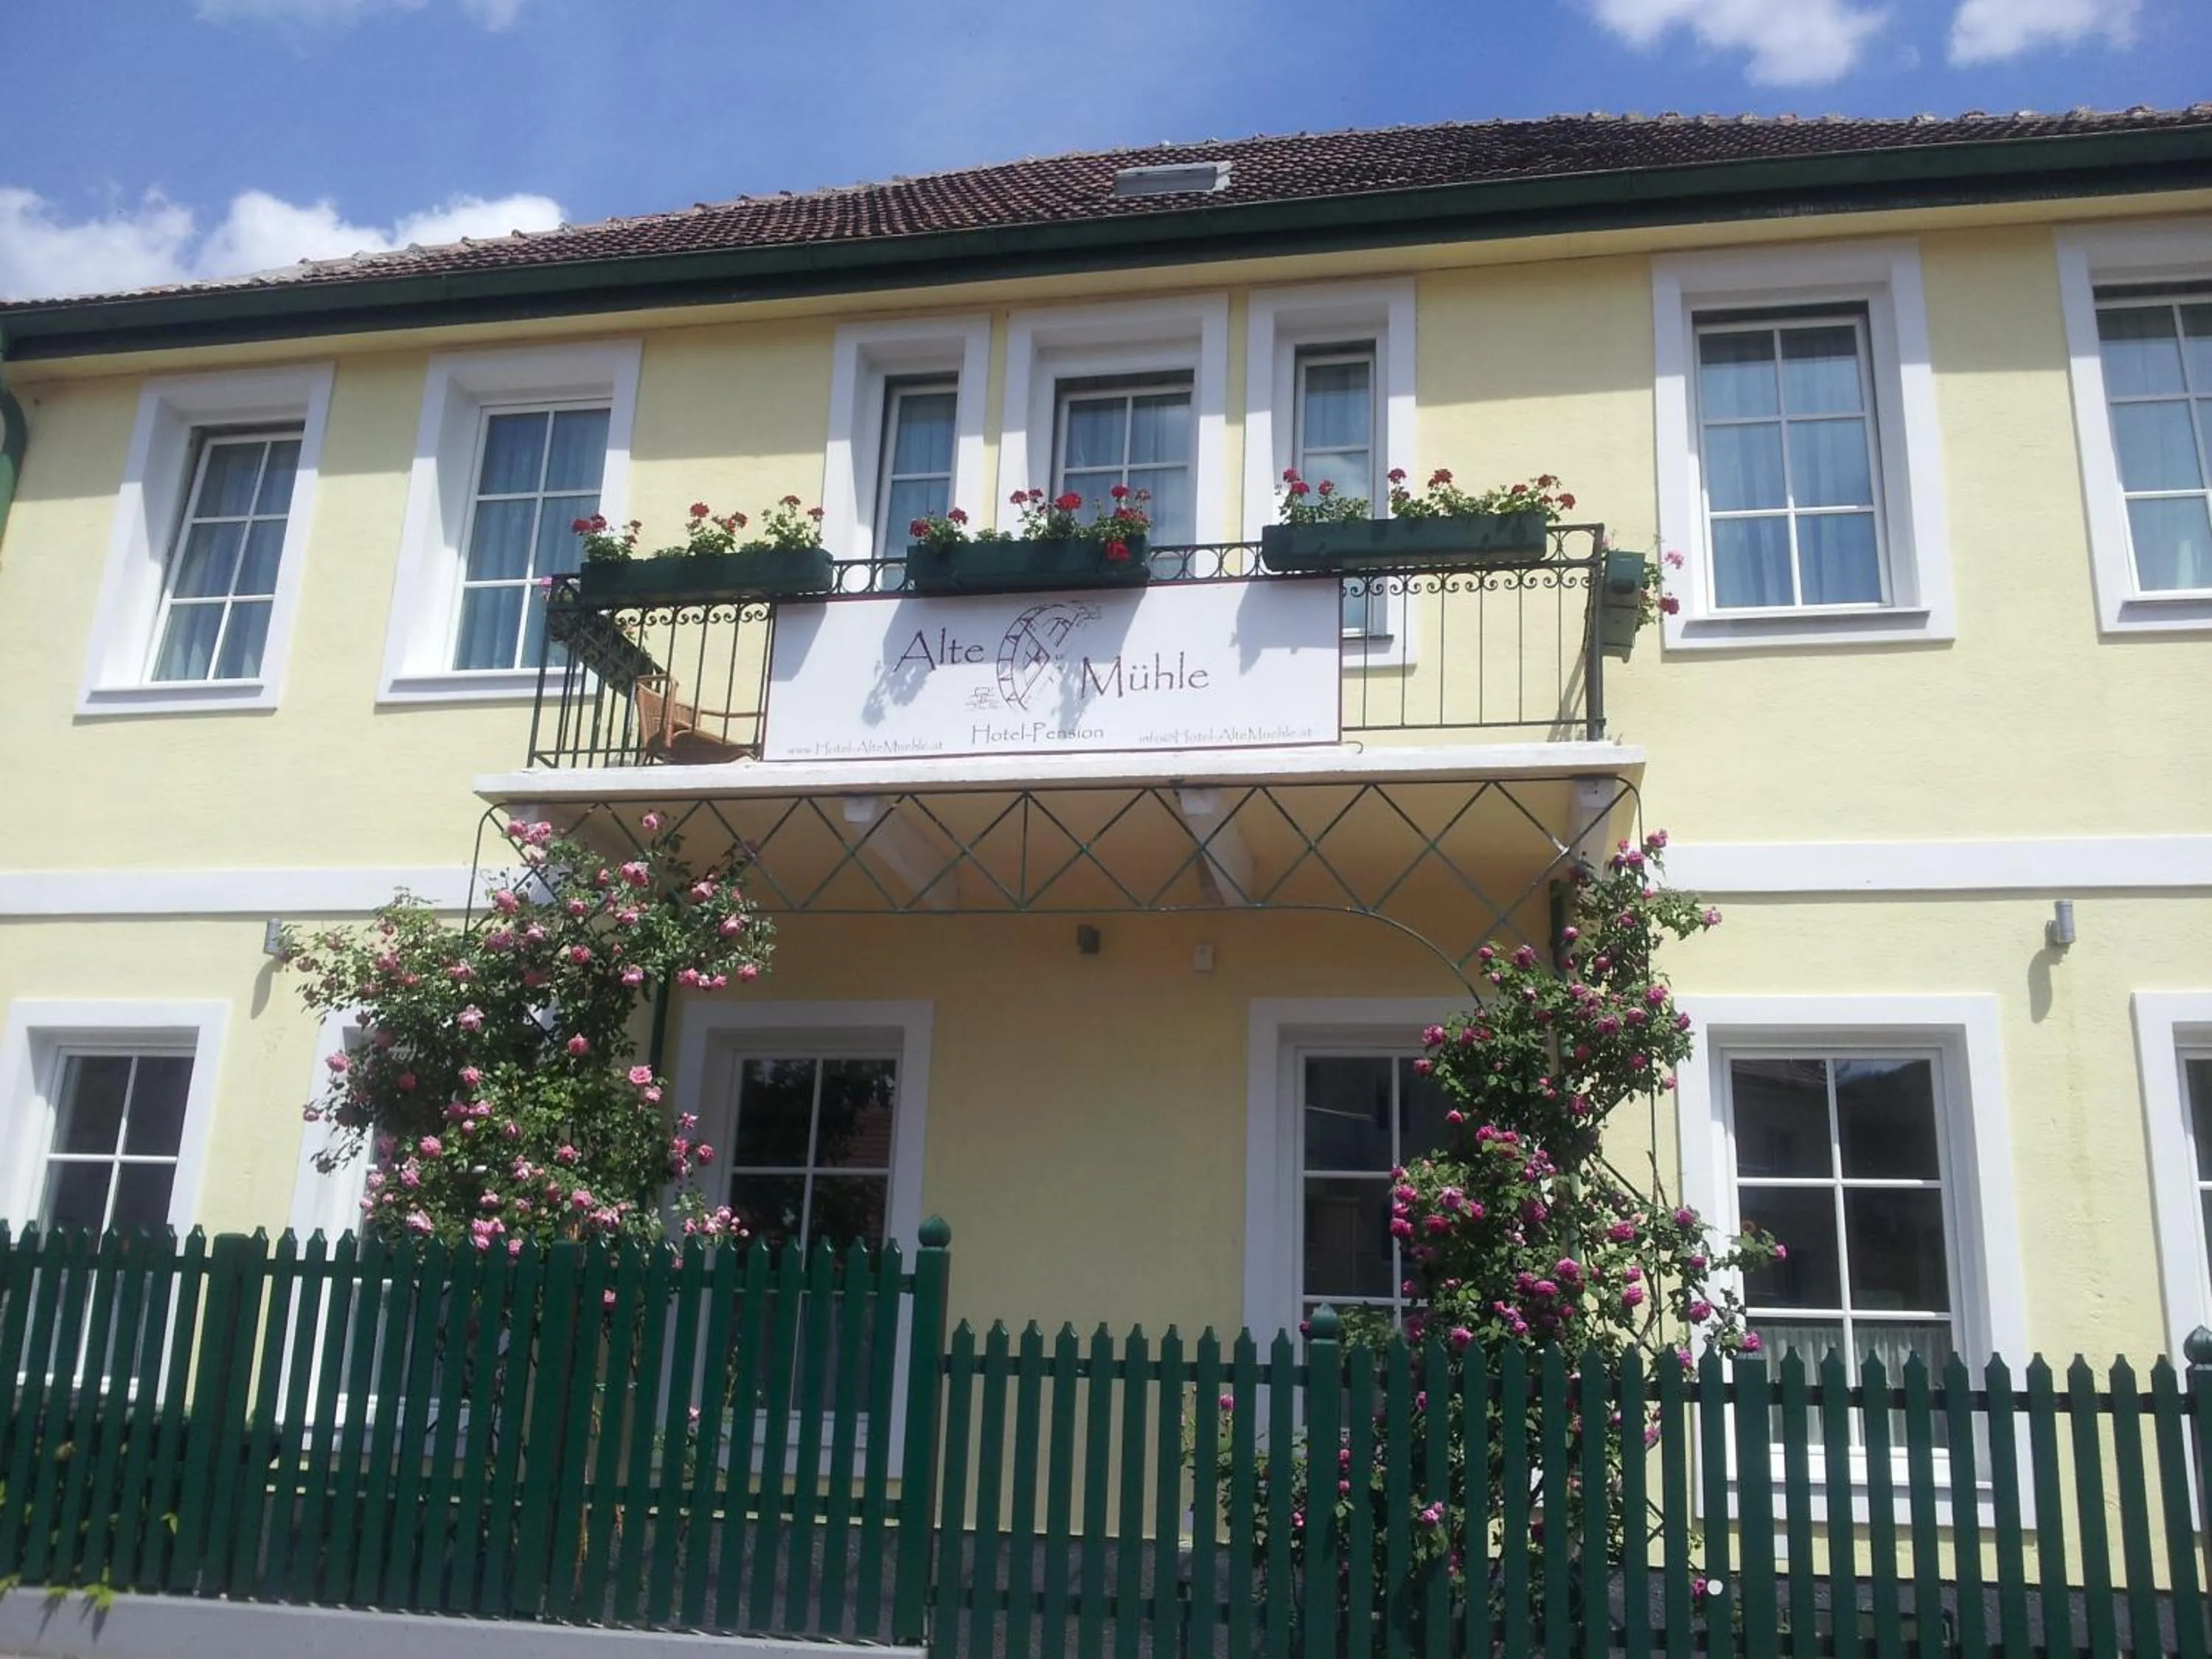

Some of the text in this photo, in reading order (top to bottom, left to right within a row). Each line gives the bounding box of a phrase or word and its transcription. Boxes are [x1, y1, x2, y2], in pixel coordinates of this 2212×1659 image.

[894, 627, 1210, 698] Alte Mühle
[971, 722, 1105, 744] Hotel-Pension
